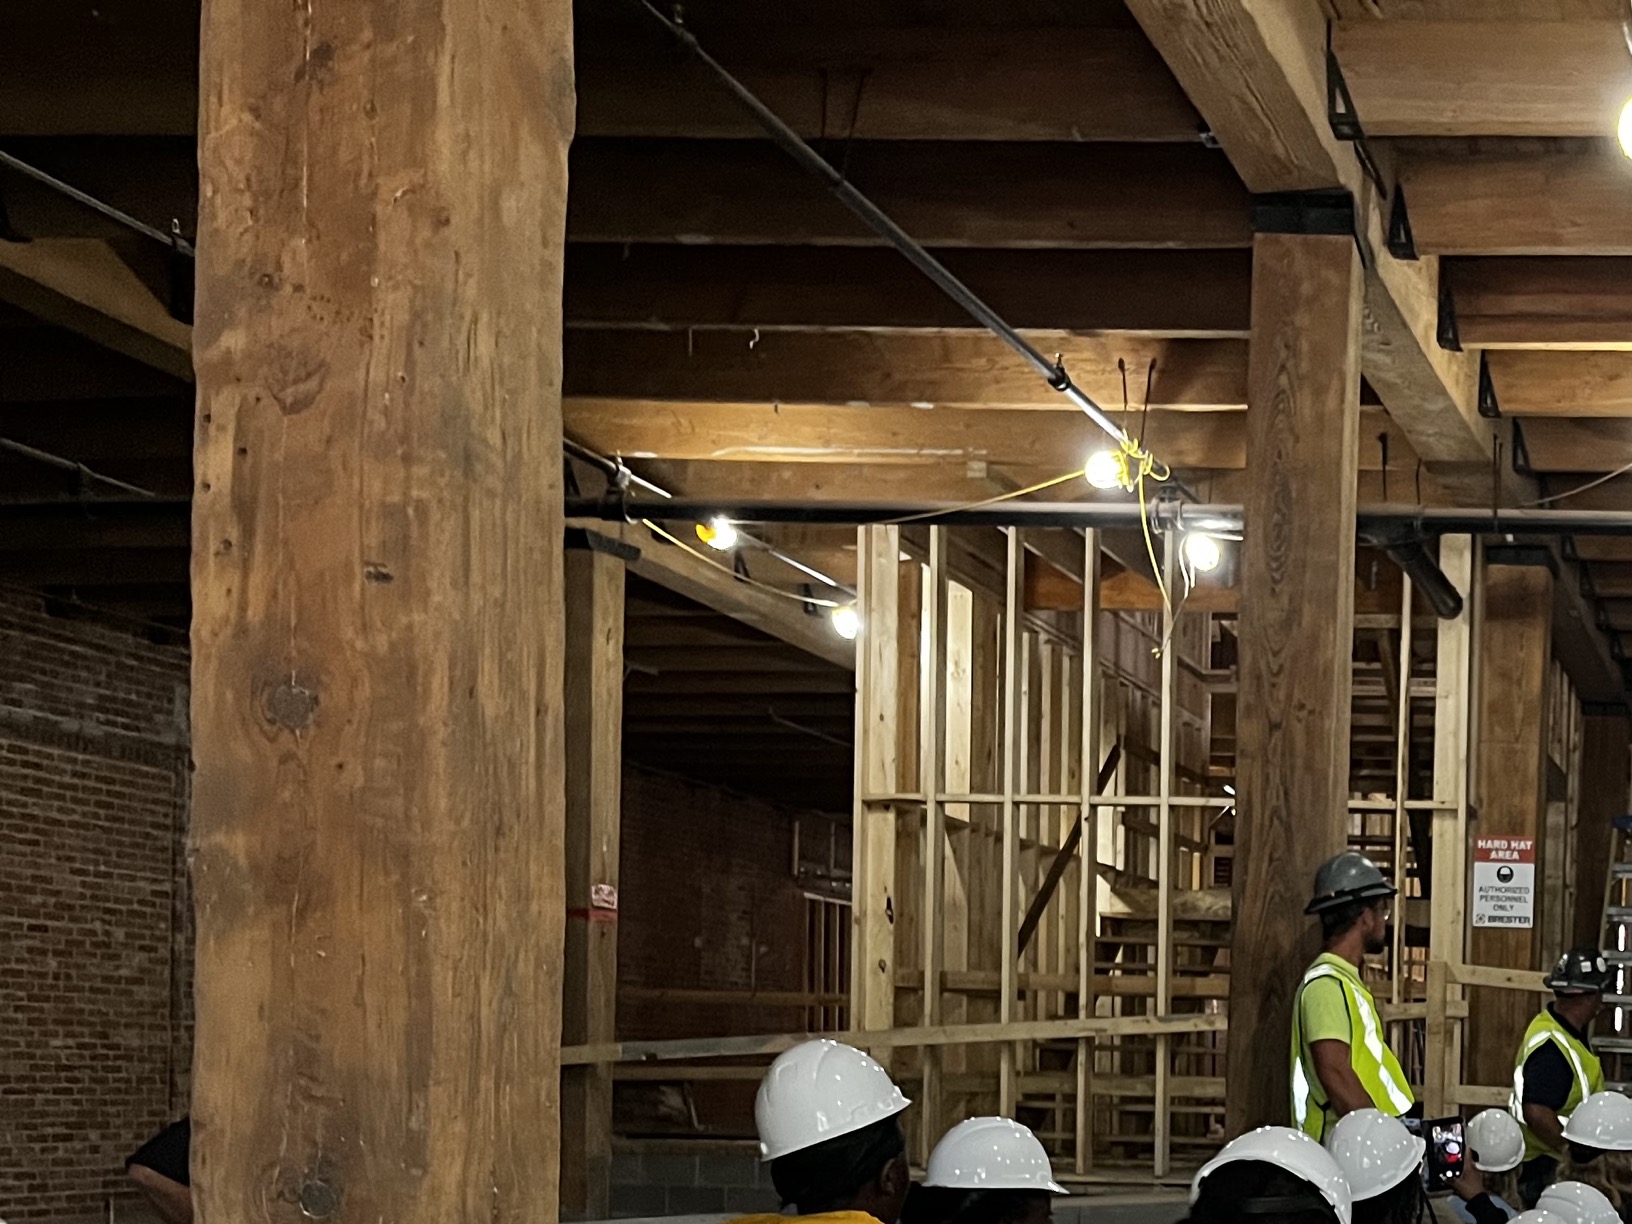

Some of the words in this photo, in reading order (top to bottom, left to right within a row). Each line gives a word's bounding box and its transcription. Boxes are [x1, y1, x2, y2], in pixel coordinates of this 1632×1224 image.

[1477, 839, 1508, 850] HARD
[1510, 839, 1533, 850] HAT
[1489, 850, 1520, 860] AREA
[1478, 885, 1530, 895] AUTHORIZED
[1479, 895, 1529, 904] PERSONNEL
[1492, 904, 1515, 912] ONLY
